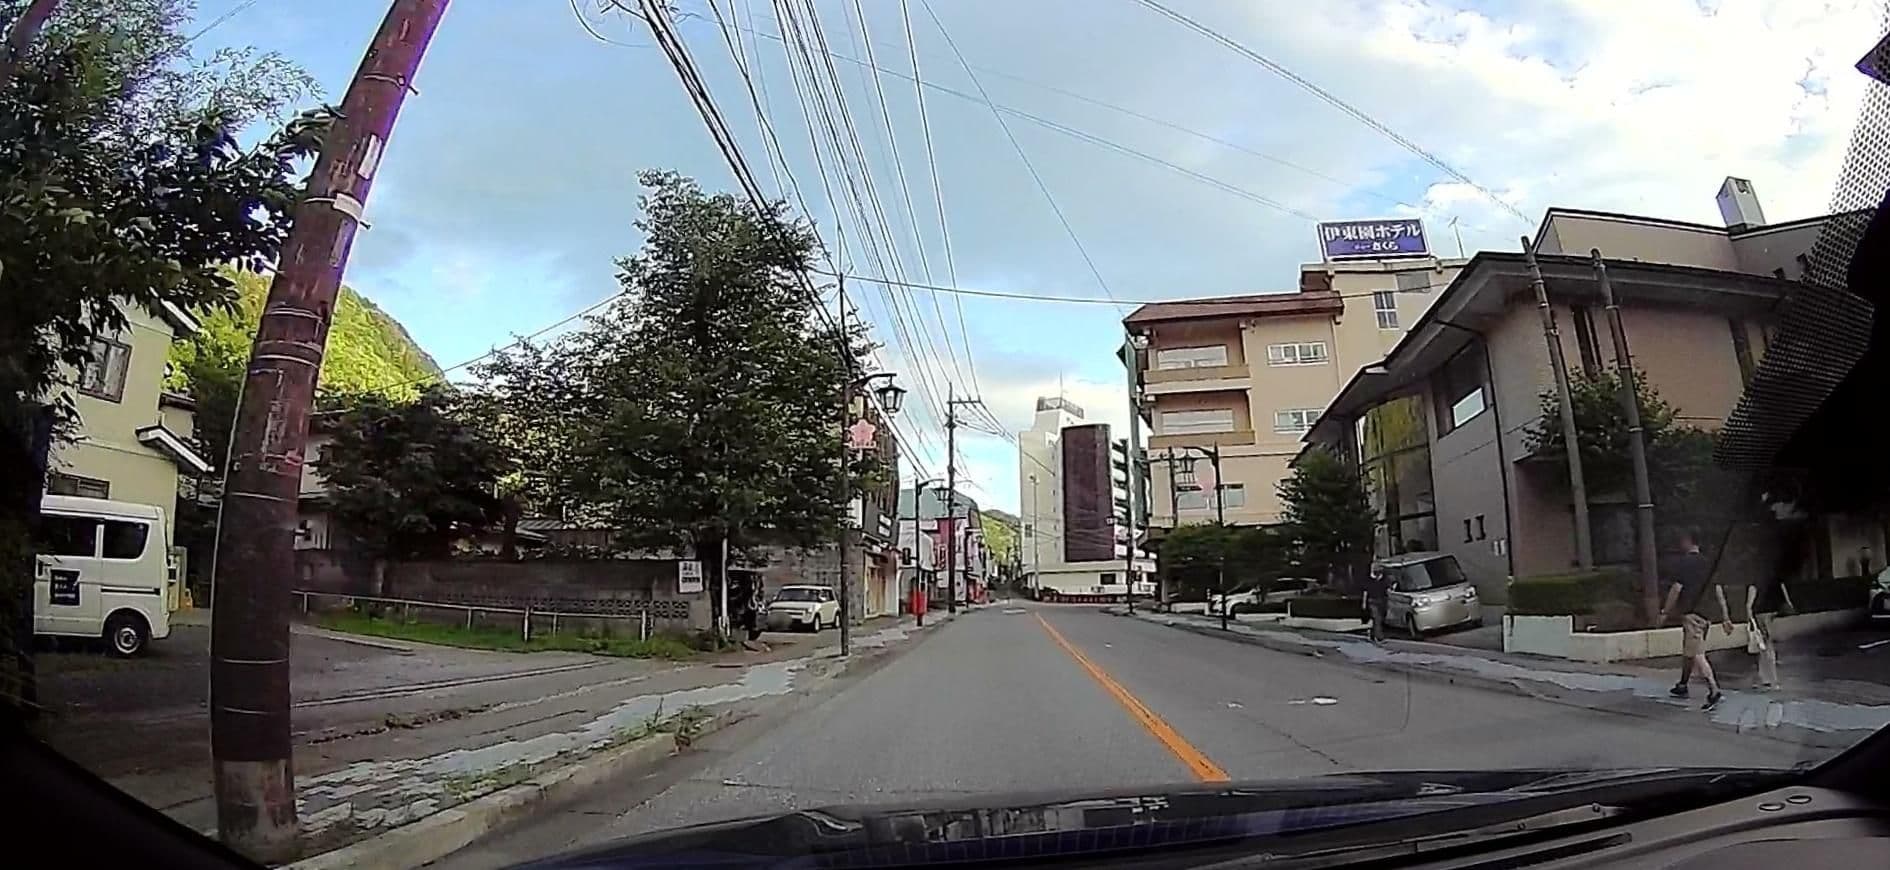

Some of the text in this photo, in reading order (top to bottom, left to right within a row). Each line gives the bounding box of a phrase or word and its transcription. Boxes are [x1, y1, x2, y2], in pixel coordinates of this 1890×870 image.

[1324, 224, 1421, 241] 伊東園ホテル
